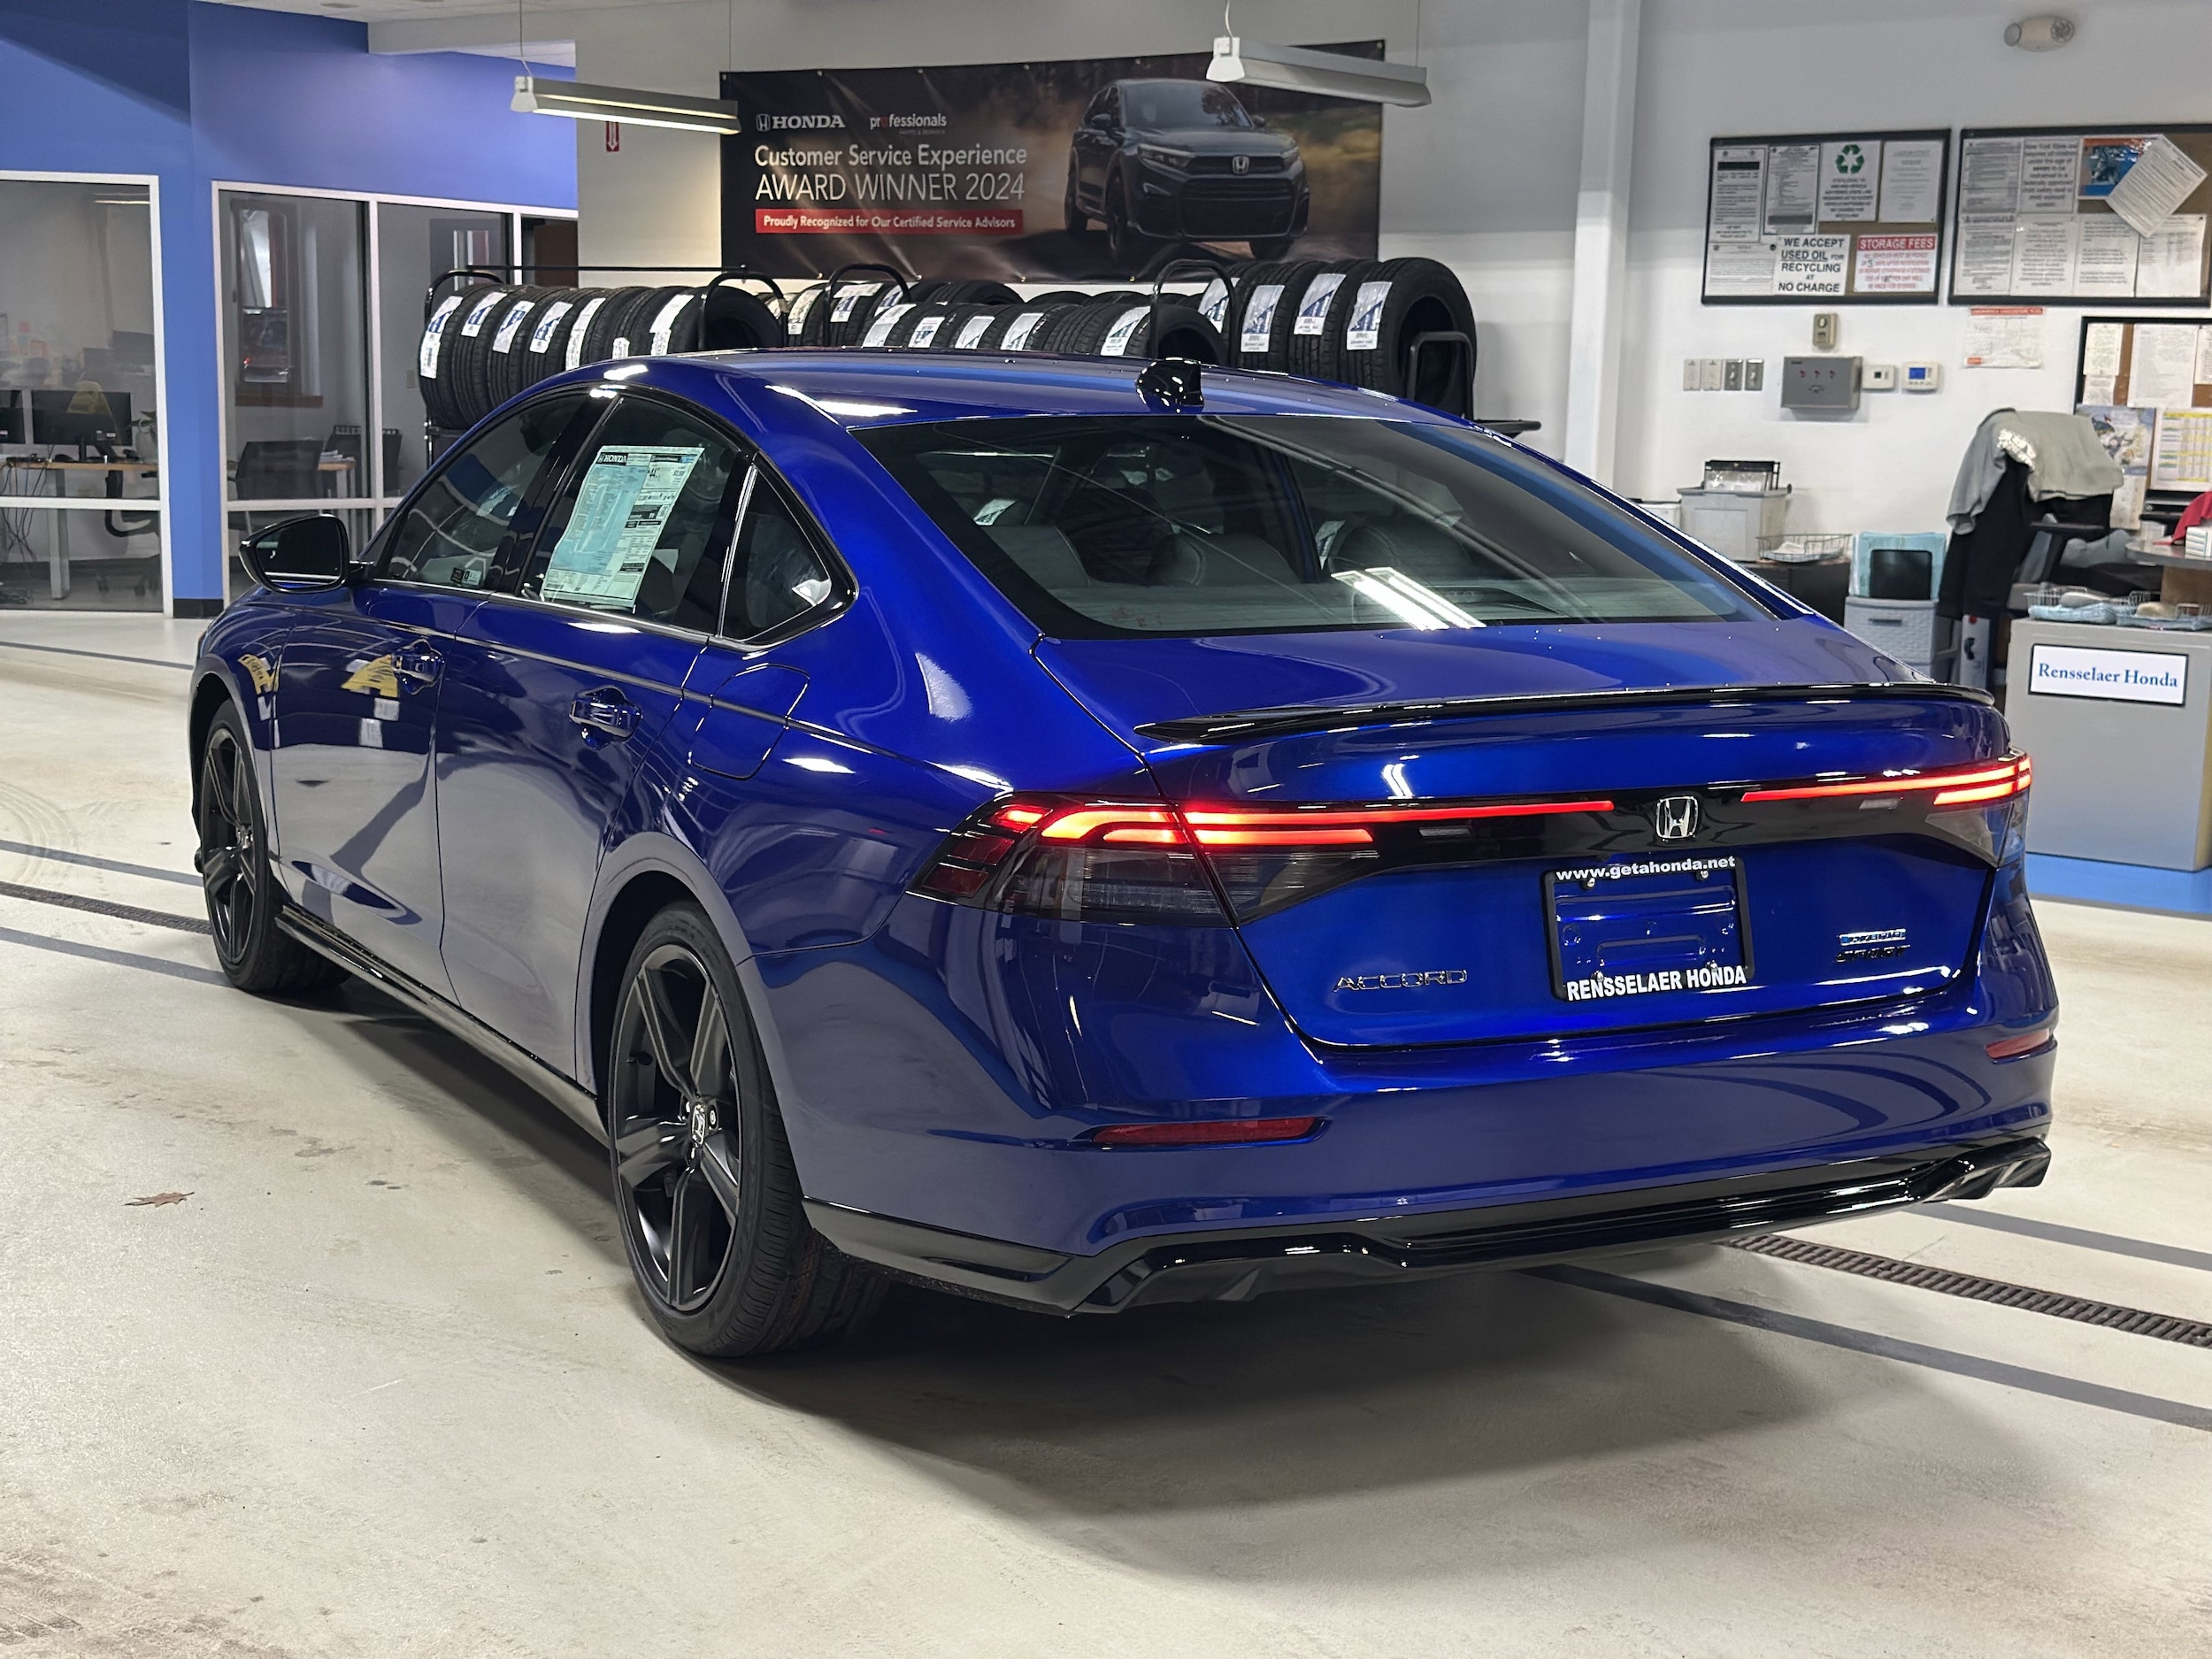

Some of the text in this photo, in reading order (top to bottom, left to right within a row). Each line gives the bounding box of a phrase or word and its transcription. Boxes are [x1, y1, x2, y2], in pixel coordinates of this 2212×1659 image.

[772, 114, 846, 130] HONDA
[754, 143, 1027, 172] Customer Service Experience
[755, 173, 1025, 201] AWARD WINNER 2024
[764, 215, 1016, 230] Proudly Recognized for Our Certified Service Advisors
[1784, 238, 1845, 248] WE ACCEPT
[1860, 237, 1934, 250] STORAGE FEES
[1781, 250, 1809, 259] USED
[1811, 250, 1828, 260] OIL
[1781, 263, 1840, 273] RECYCLING
[1778, 282, 1840, 293] NO CHARGE
[2039, 663, 2178, 687] Rensselaer Honda
[1555, 856, 1736, 880] www.getahonda.net
[1332, 969, 1468, 993] ACCORD
[1566, 964, 1747, 1002] RENSSELAER HONDA
